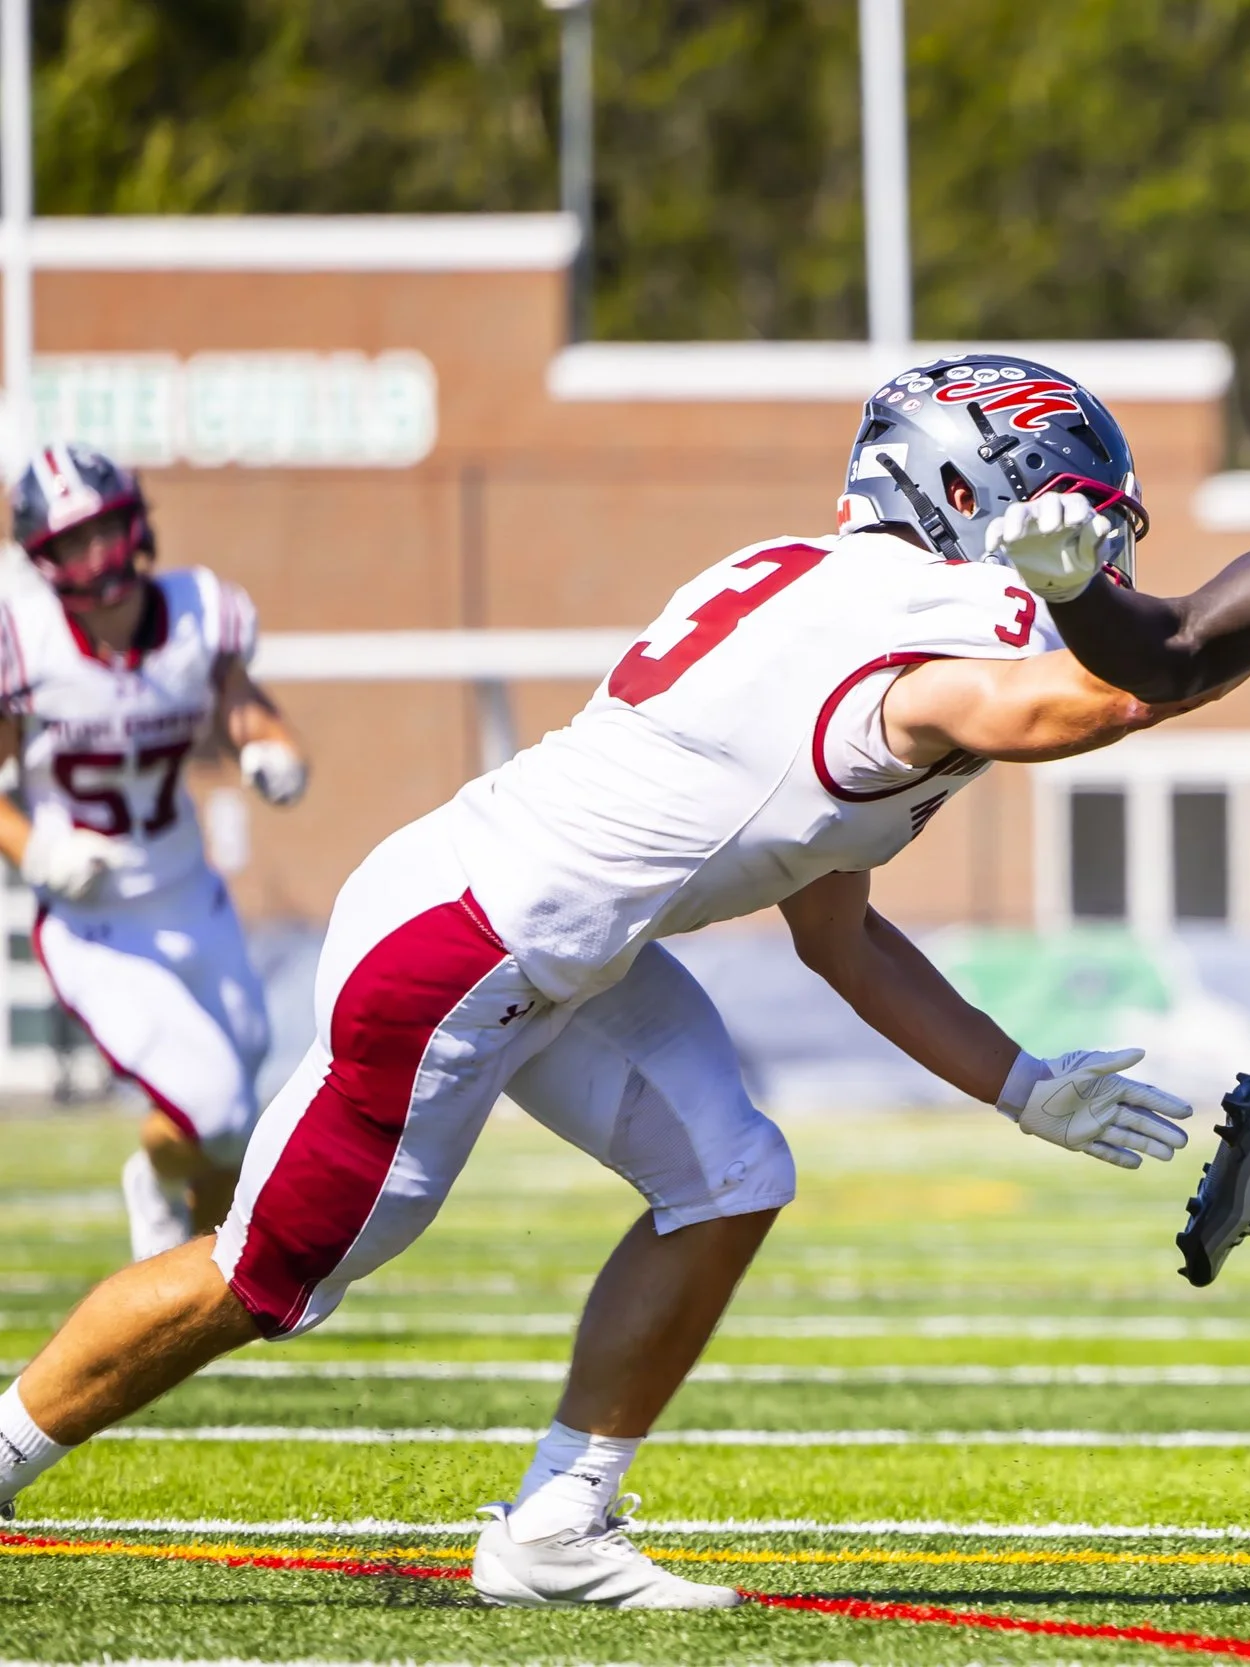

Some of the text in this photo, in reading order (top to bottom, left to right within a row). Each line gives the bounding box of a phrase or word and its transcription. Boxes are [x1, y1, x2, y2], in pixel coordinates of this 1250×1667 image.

[608, 543, 832, 707] 3
[994, 586, 1036, 648] 3
[54, 741, 191, 838] 57
